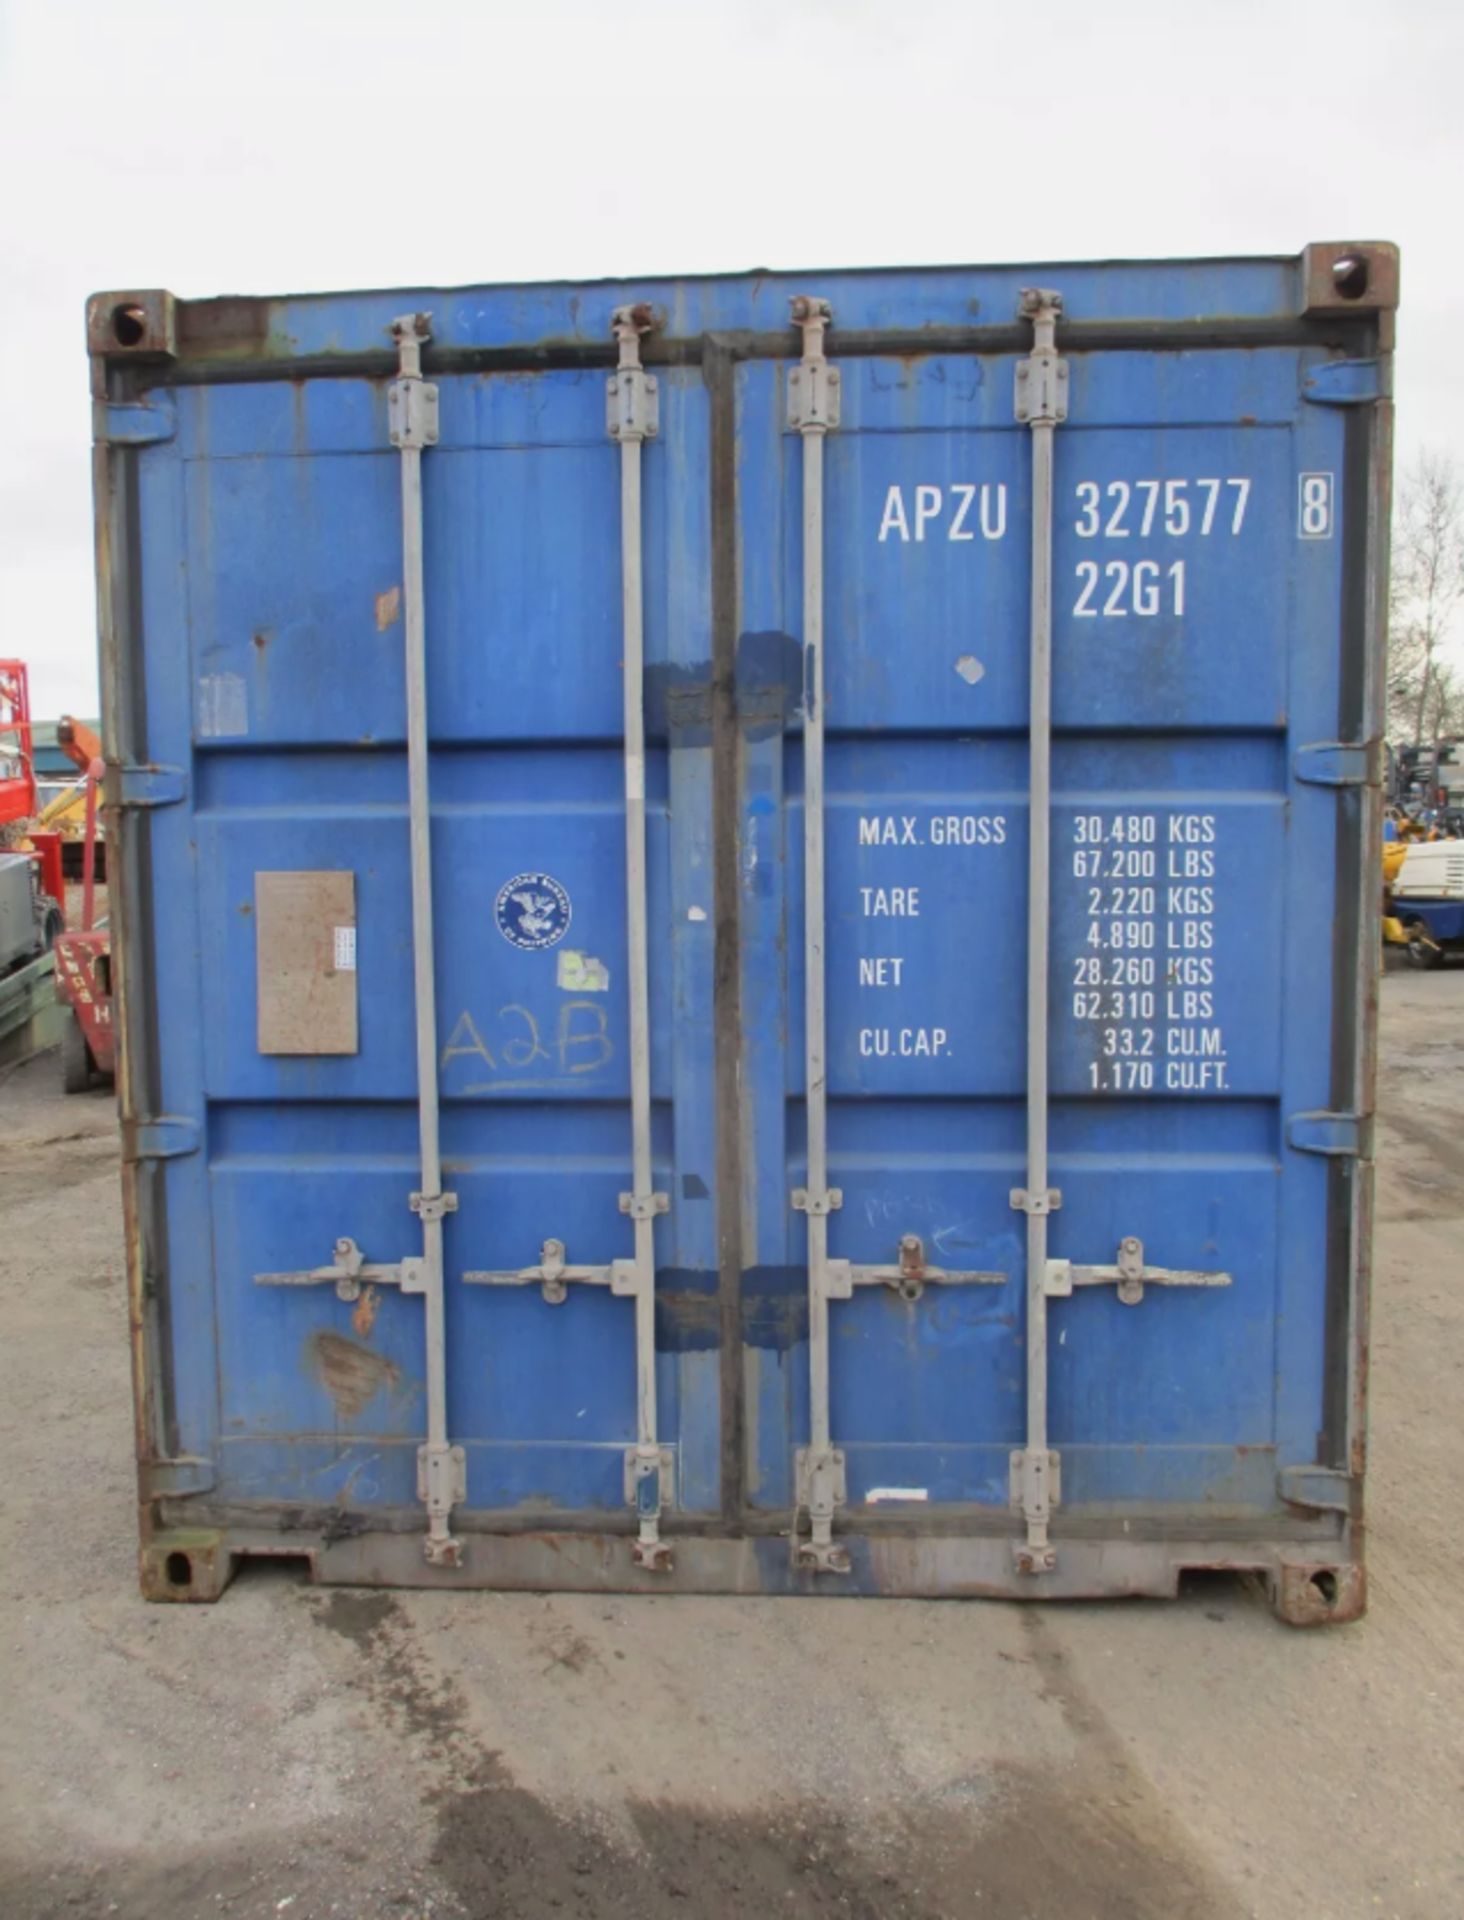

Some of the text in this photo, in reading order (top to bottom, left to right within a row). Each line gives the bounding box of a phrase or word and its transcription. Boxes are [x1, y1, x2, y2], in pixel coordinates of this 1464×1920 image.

[878, 477, 1329, 542] APZU 327577 8
[1073, 560, 1186, 617] 22G1
[931, 816, 1007, 845] GROSS
[1169, 815, 1216, 843] KGS
[1168, 849, 1215, 878] LBS
[860, 887, 920, 916] TARE
[1168, 886, 1214, 915] KGS
[1167, 921, 1213, 949] LBS
[859, 958, 904, 986] NET
[1167, 957, 1213, 985] KGS
[1167, 991, 1213, 1019] LBS
[440, 1000, 614, 1075] A2B
[1102, 1028, 1154, 1057] 33.2
